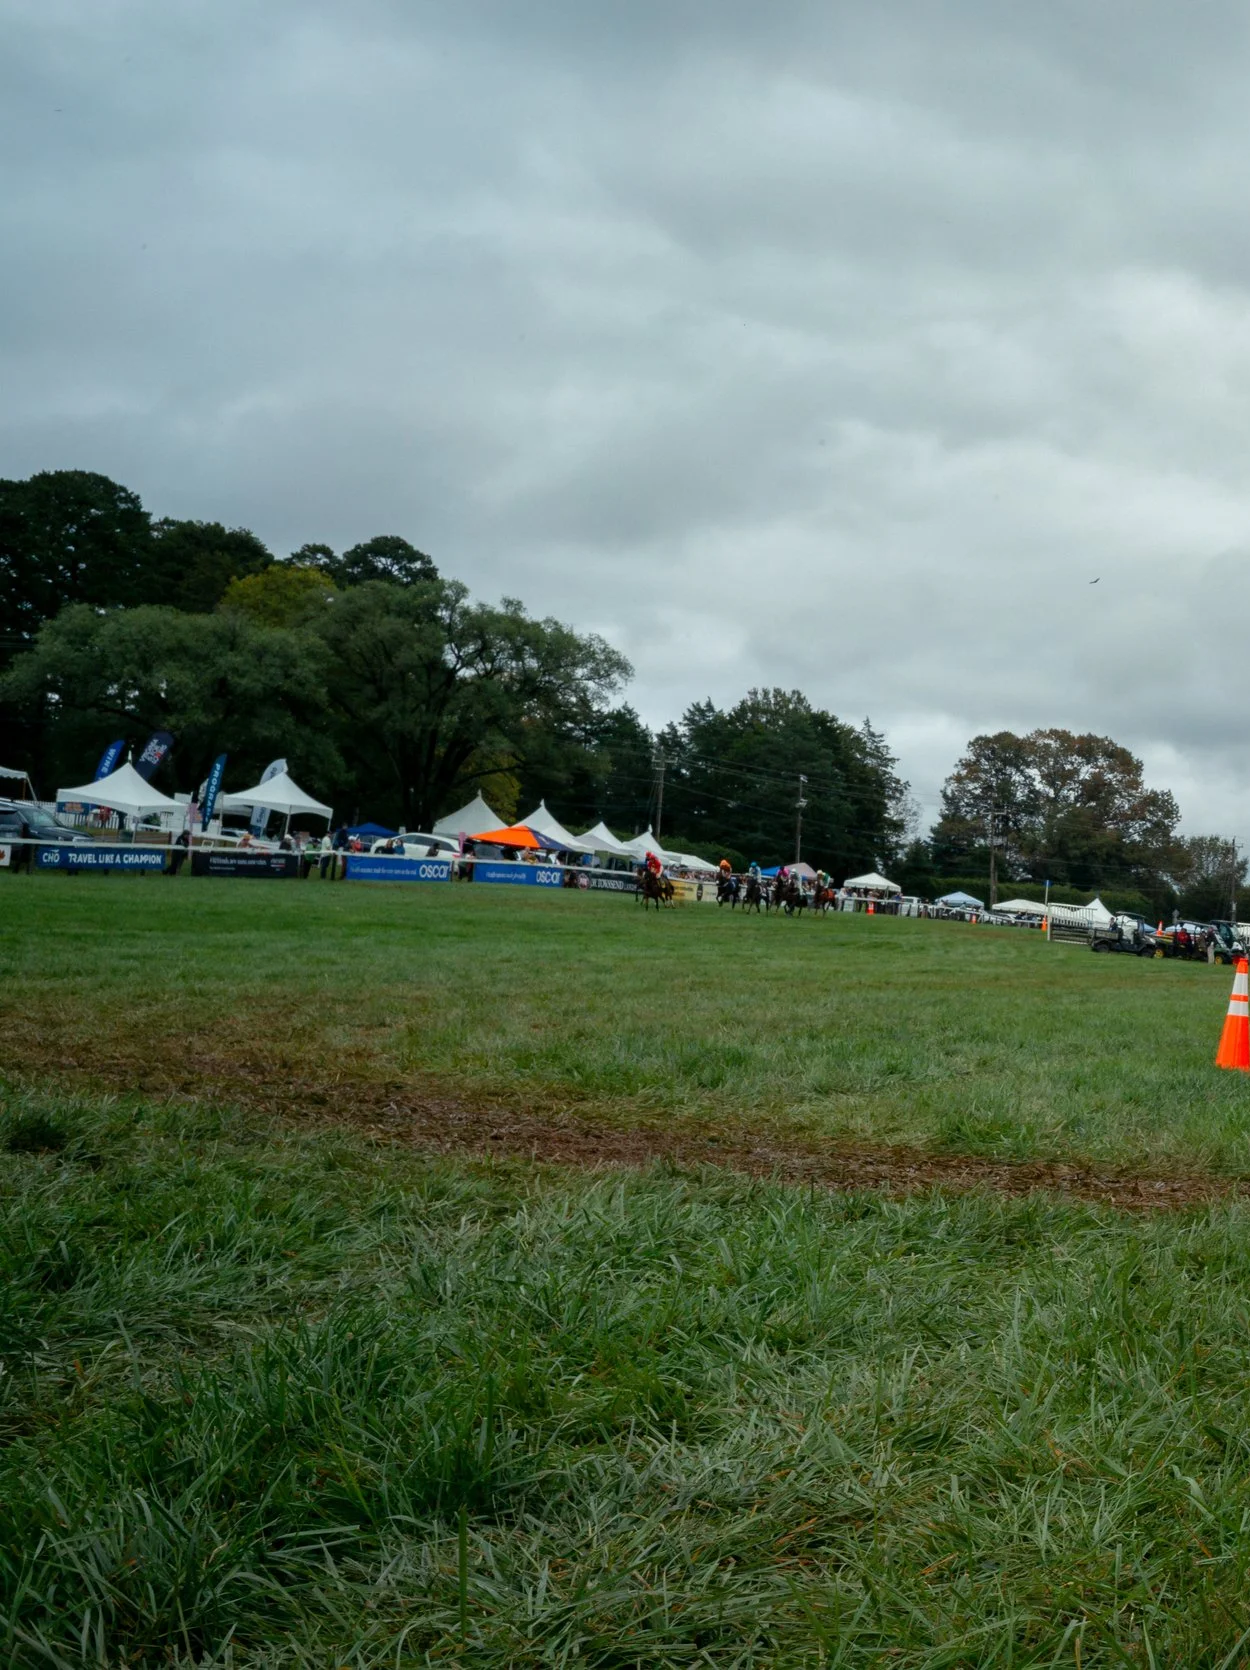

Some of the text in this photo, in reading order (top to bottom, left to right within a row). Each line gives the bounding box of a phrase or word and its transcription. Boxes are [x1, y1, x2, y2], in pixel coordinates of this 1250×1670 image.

[101, 748, 116, 774] WINE
[42, 852, 162, 865] CHO TRAVEL LIKE A CHAMPION
[597, 878, 624, 890] TOWNSEND
